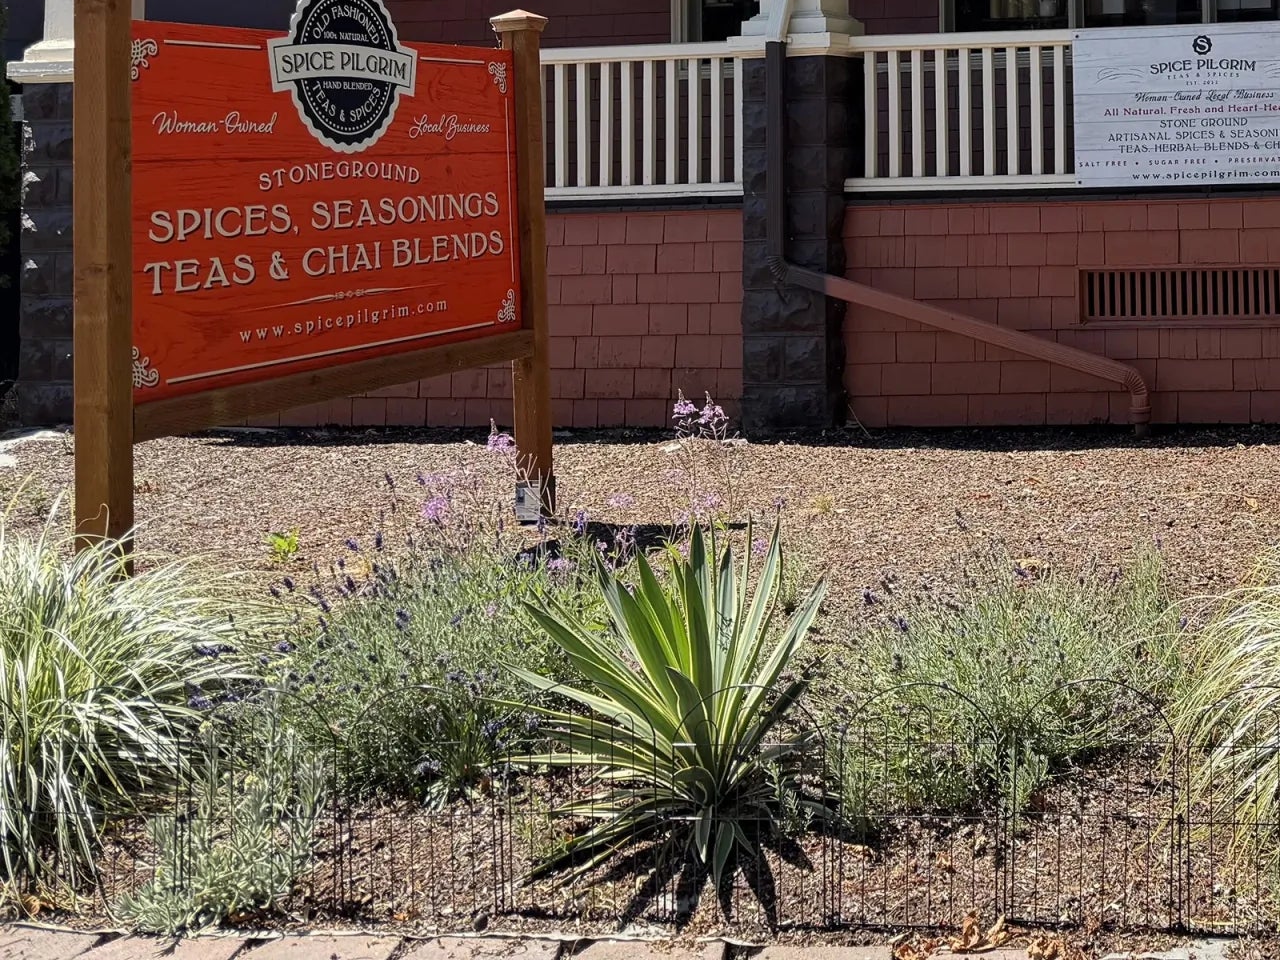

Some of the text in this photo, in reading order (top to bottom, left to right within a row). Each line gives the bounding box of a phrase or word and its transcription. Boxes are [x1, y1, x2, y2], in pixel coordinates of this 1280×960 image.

[312, 5, 380, 44] OLD FASHIONED
[339, 32, 370, 42] NATURAL
[281, 51, 408, 80] SPICE PILGRIM
[1150, 58, 1257, 75] SPICE PILGRIM
[322, 80, 373, 91] HAND BLENDED
[1134, 89, 1275, 102] Woman-Owned Local Business
[312, 80, 381, 122] TEAS & SPICES
[1104, 108, 1119, 117] All
[1170, 105, 1201, 115] Fresh
[1204, 105, 1224, 113] and
[152, 110, 278, 135] Woman-Owned
[409, 114, 490, 140] Local Business
[1160, 117, 1248, 129] STONE GROUND
[1108, 132, 1171, 142] ARTISANAL
[1175, 130, 1215, 140] SPICES
[1219, 130, 1225, 139] &
[1154, 143, 1199, 153] HERBAL
[1204, 141, 1250, 151] BLENDS
[1253, 141, 1260, 150] &
[258, 161, 421, 191] STONEGROUND
[1132, 169, 1280, 180] www.spicepilgrim.com
[148, 192, 500, 242] SPICES, SEASONINGS
[144, 231, 504, 295] TEAS & CHAI BLENDS
[239, 300, 448, 342] www.spicepilgrim.com
